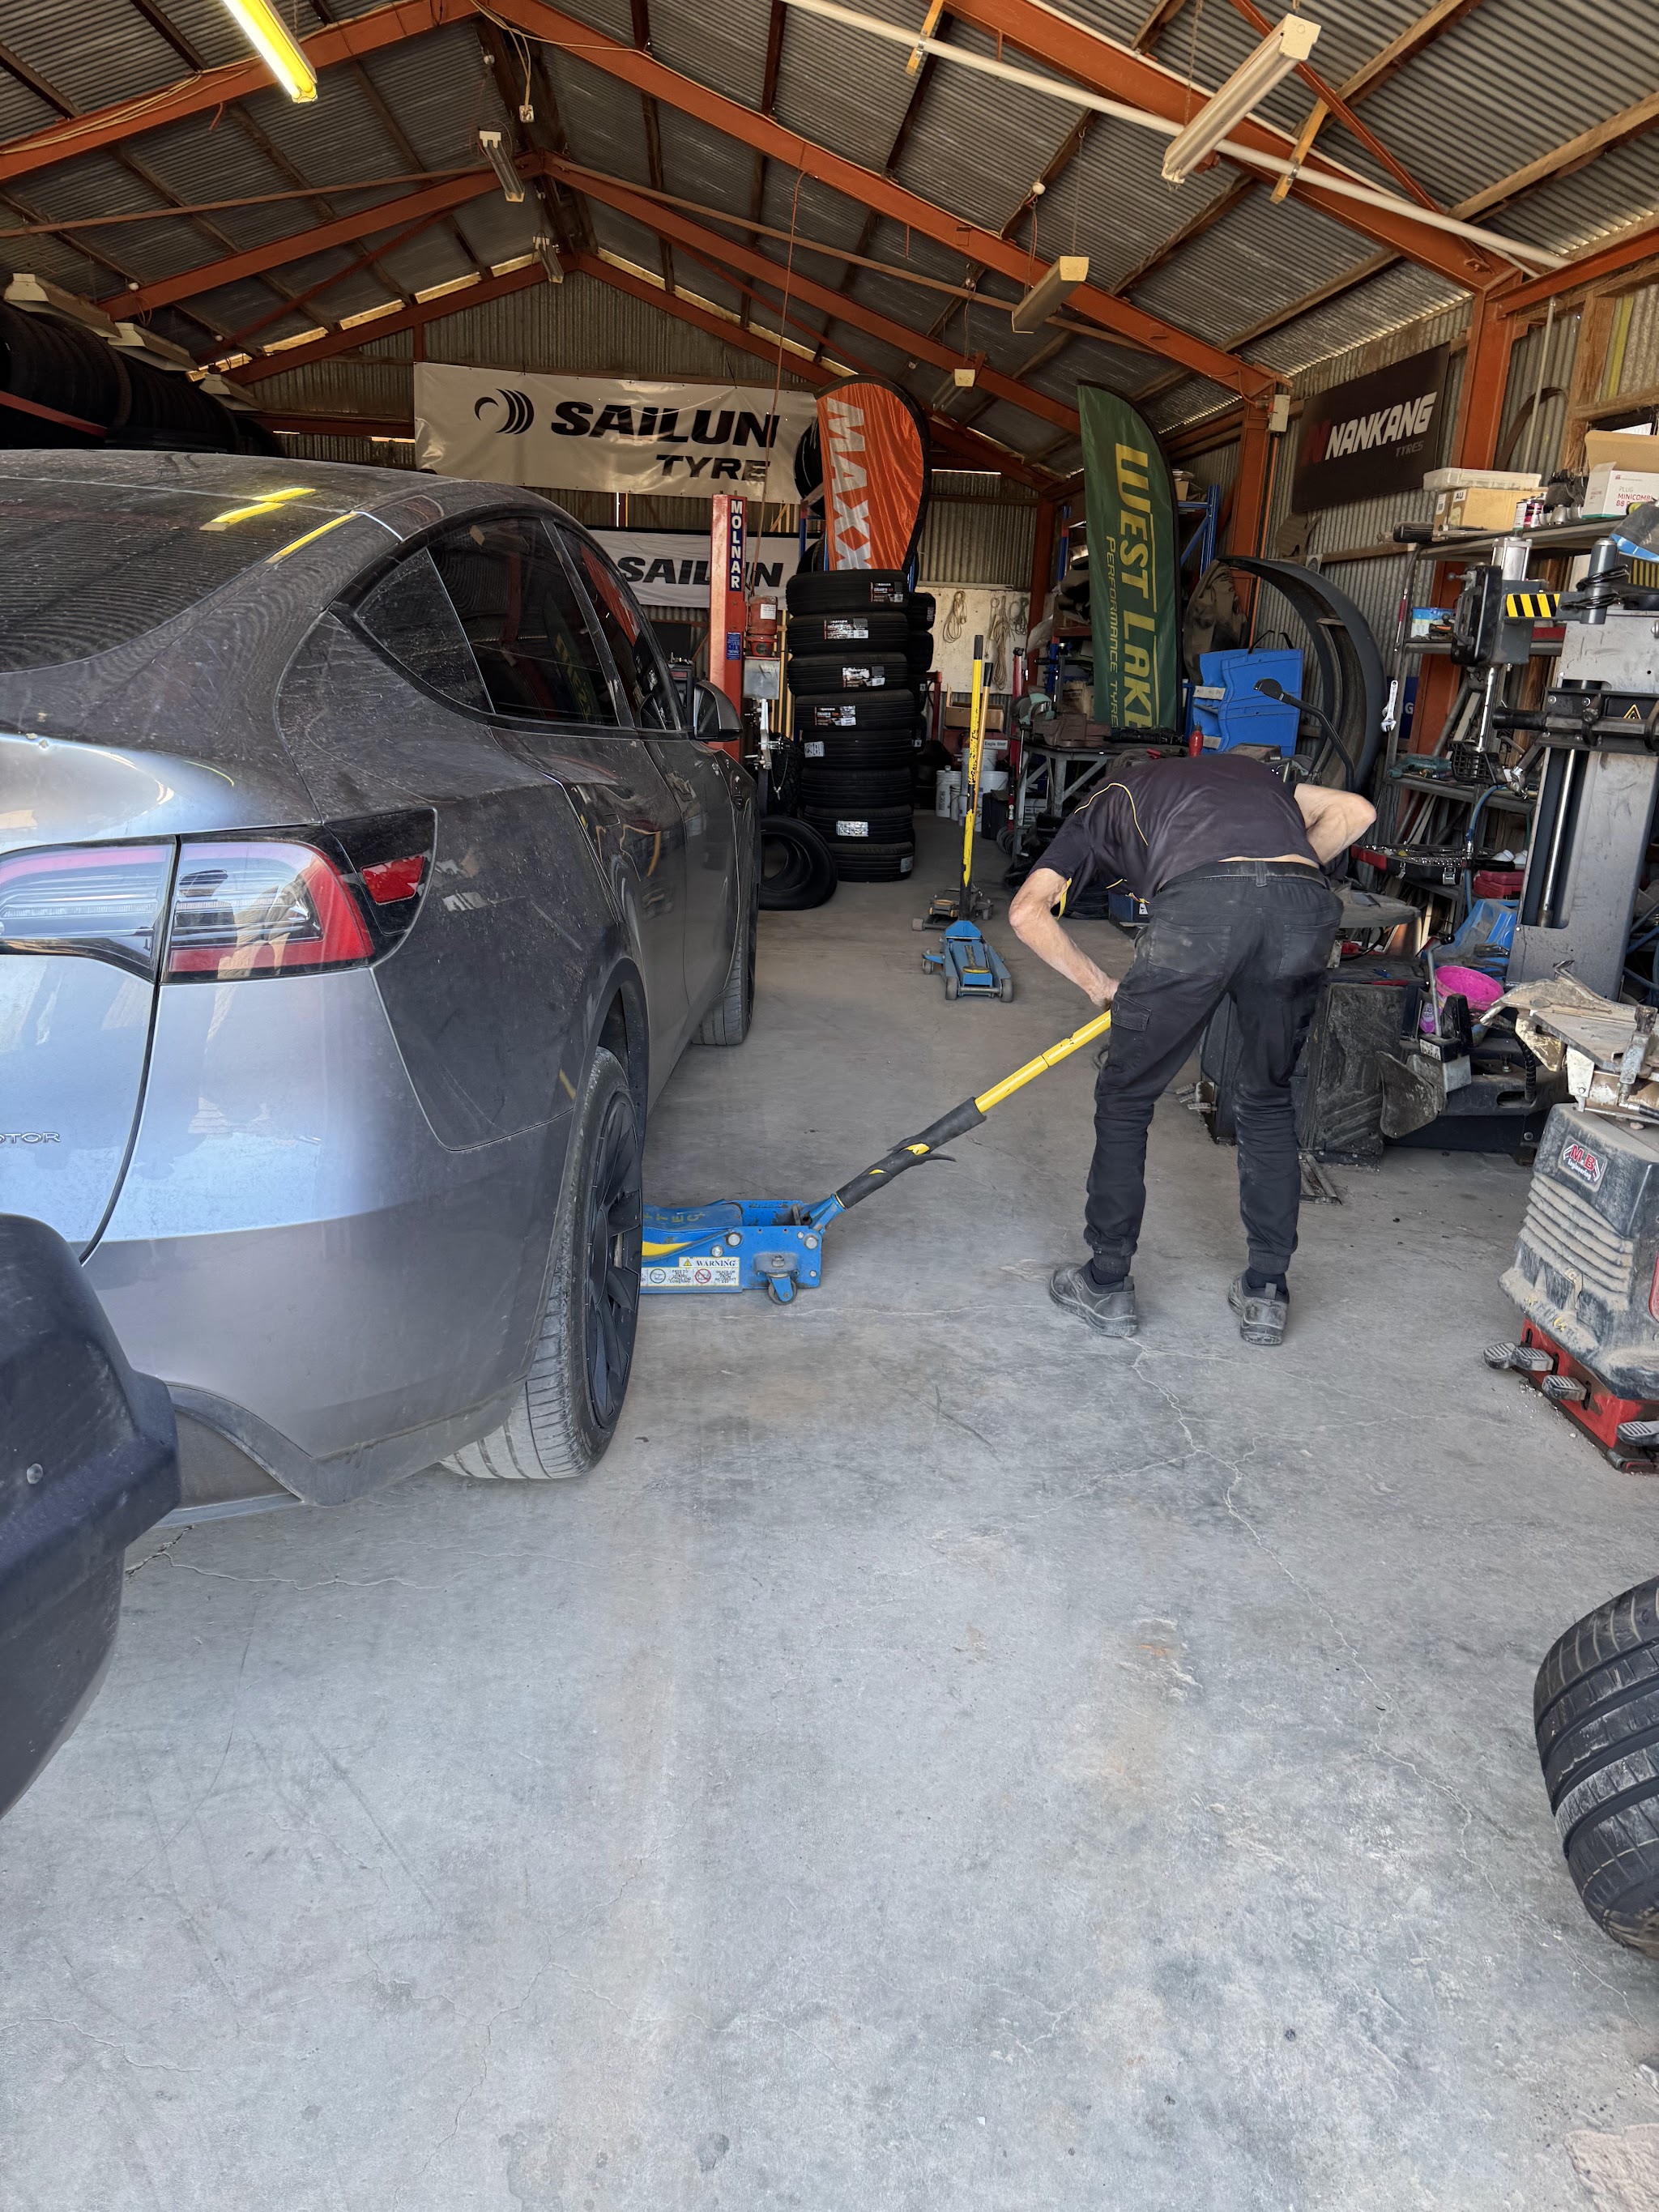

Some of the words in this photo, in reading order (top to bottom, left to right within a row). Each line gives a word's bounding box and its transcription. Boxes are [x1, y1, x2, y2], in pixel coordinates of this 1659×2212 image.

[551, 401, 780, 448] SAILUN
[1324, 391, 1438, 461] NANKANG
[655, 454, 770, 481] TYRE
[1395, 440, 1425, 458] TYRES
[1455, 491, 1465, 500] AU
[1115, 442, 1153, 599] WEST
[731, 499, 743, 590] MOLNAR
[617, 556, 784, 589] SAILN
[1106, 535, 1120, 674] PERFORMANCE
[0, 1132, 62, 1144] TOR
